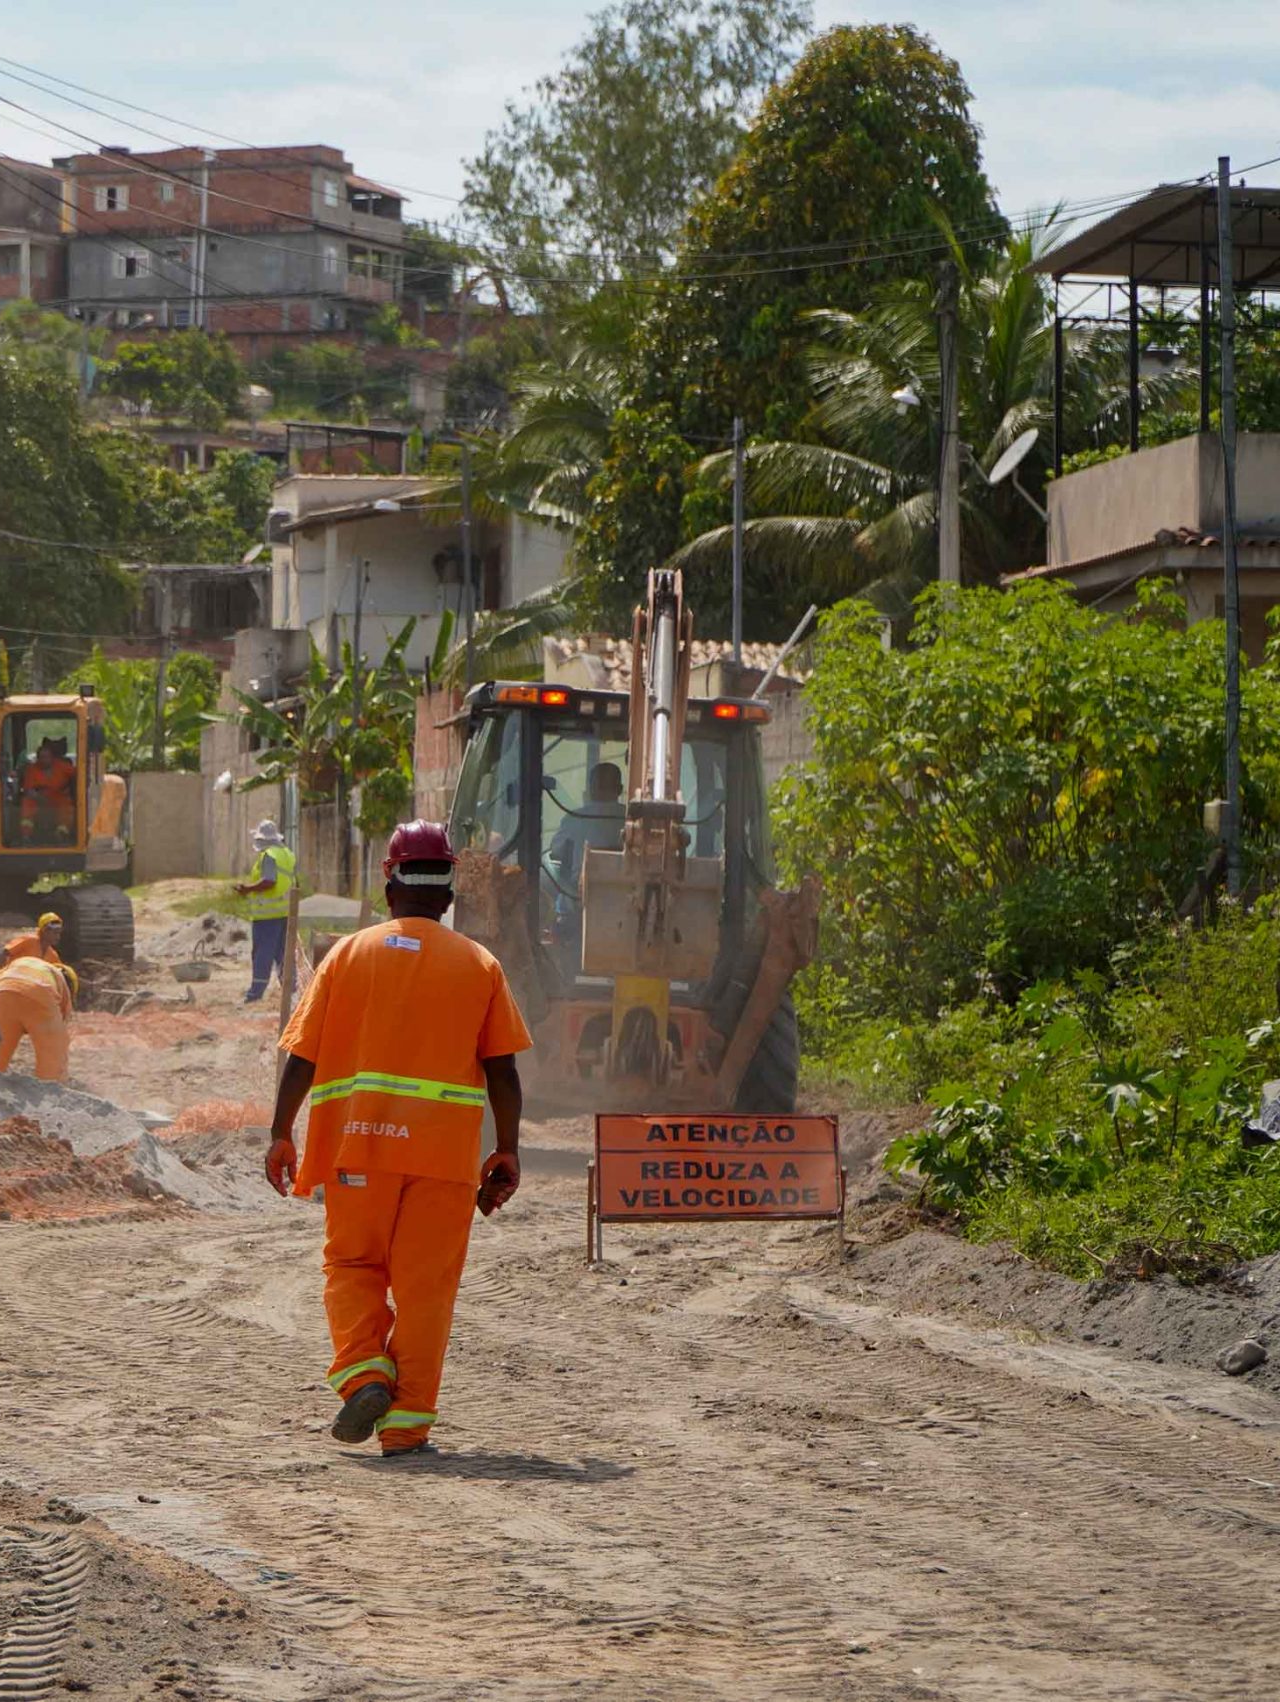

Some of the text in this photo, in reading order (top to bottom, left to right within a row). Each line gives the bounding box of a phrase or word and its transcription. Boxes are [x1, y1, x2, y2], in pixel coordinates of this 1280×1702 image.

[646, 1120, 795, 1148] ATENÇÃO
[640, 1161, 801, 1180] REDUZA A
[619, 1187, 820, 1207] VELOCIDADE
